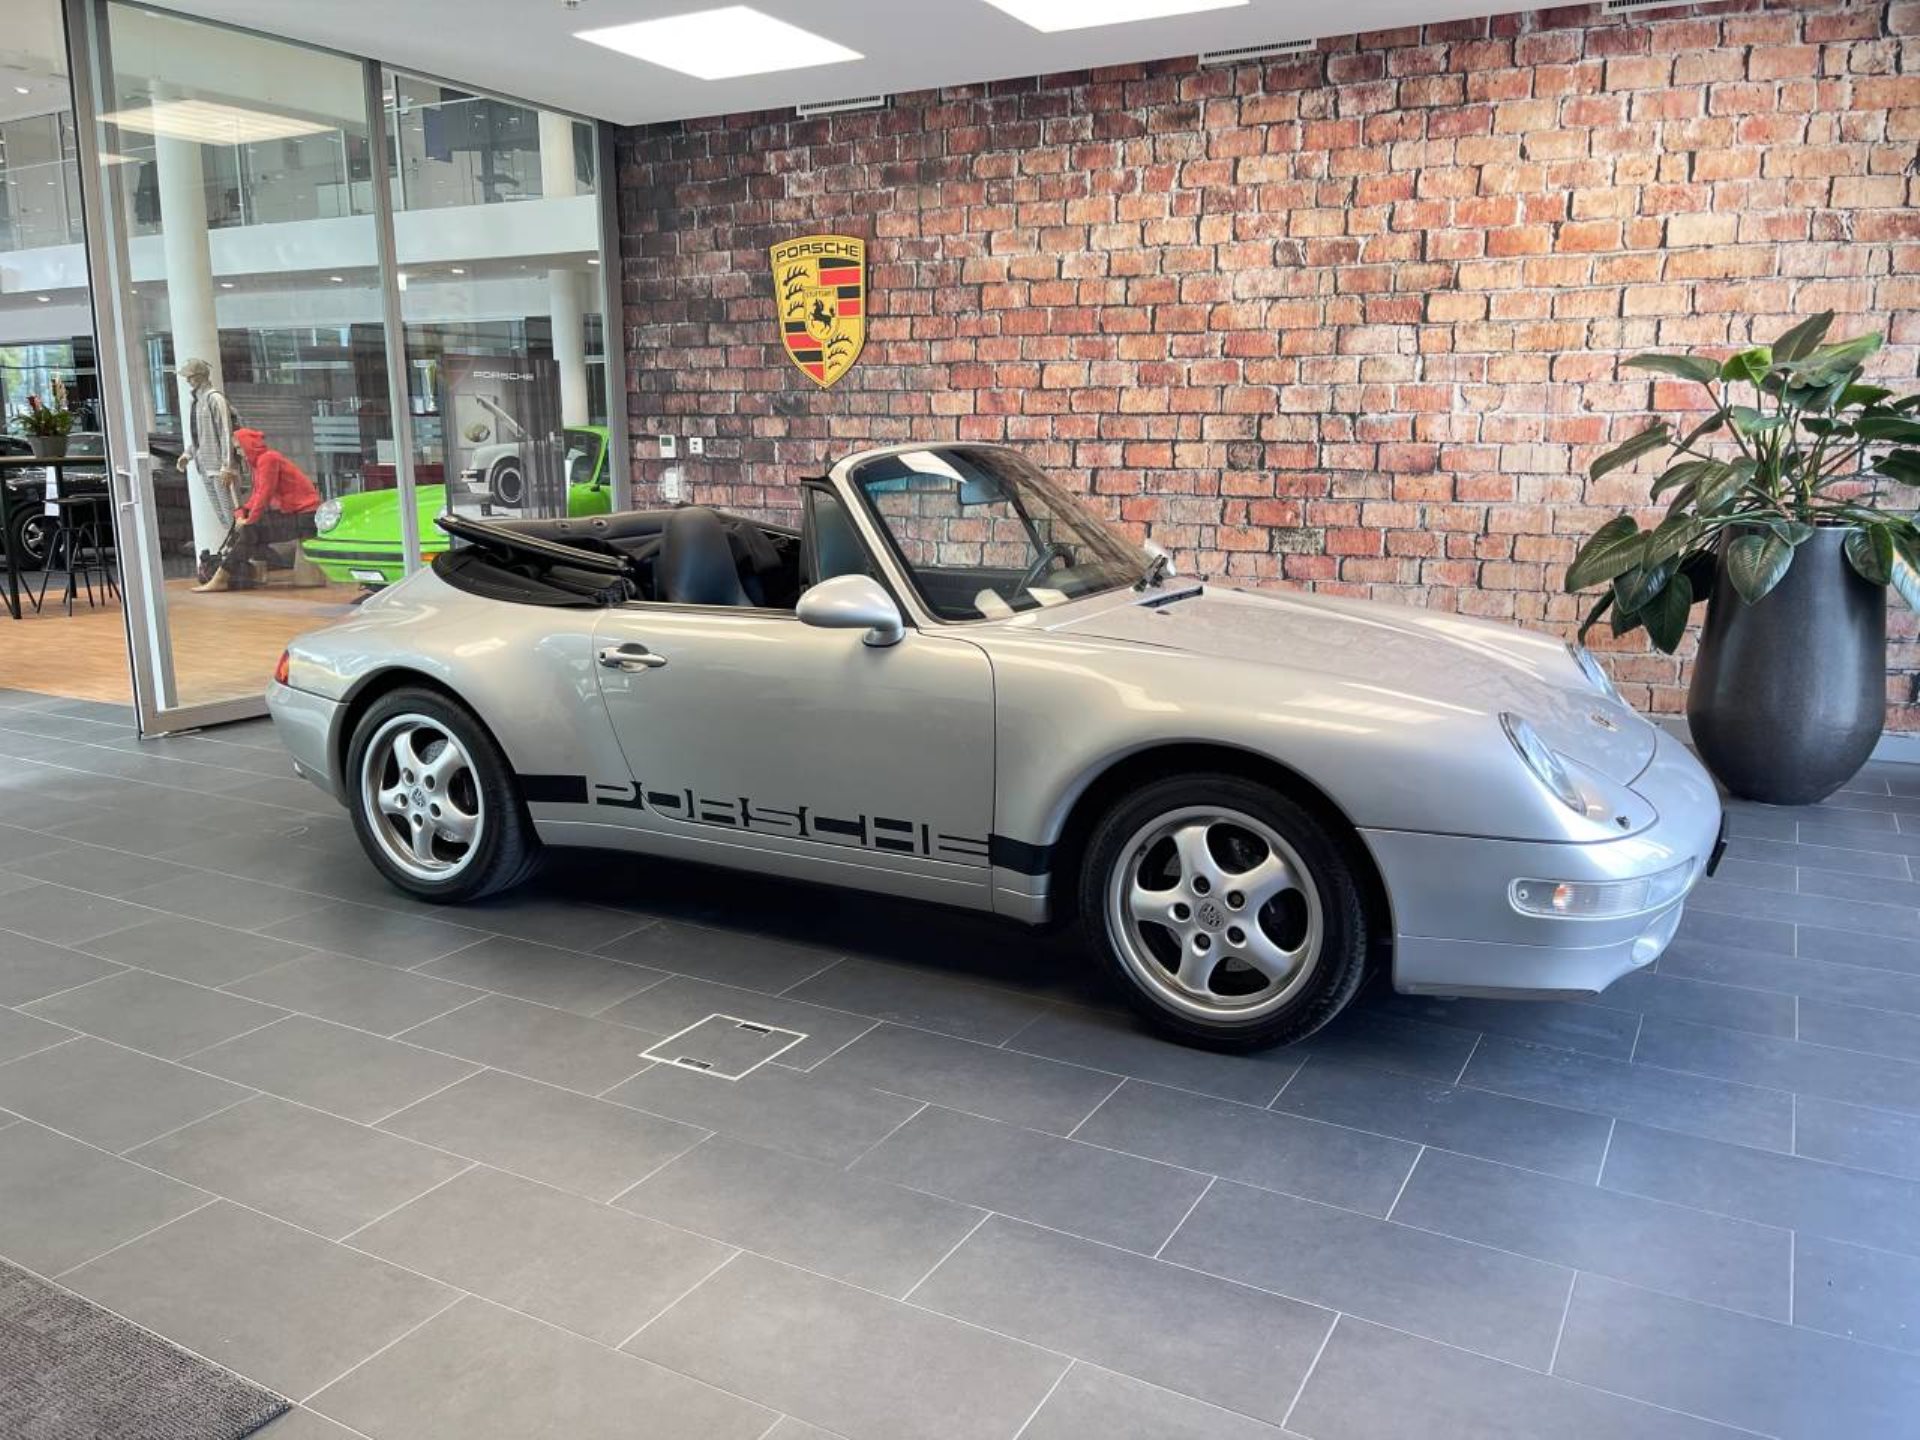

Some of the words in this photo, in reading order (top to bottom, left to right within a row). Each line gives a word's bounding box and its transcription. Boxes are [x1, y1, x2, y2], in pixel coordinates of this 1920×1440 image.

[776, 242, 859, 262] PORSCHE
[473, 371, 534, 381] PORSCHE
[588, 779, 990, 861] PORSCHE
